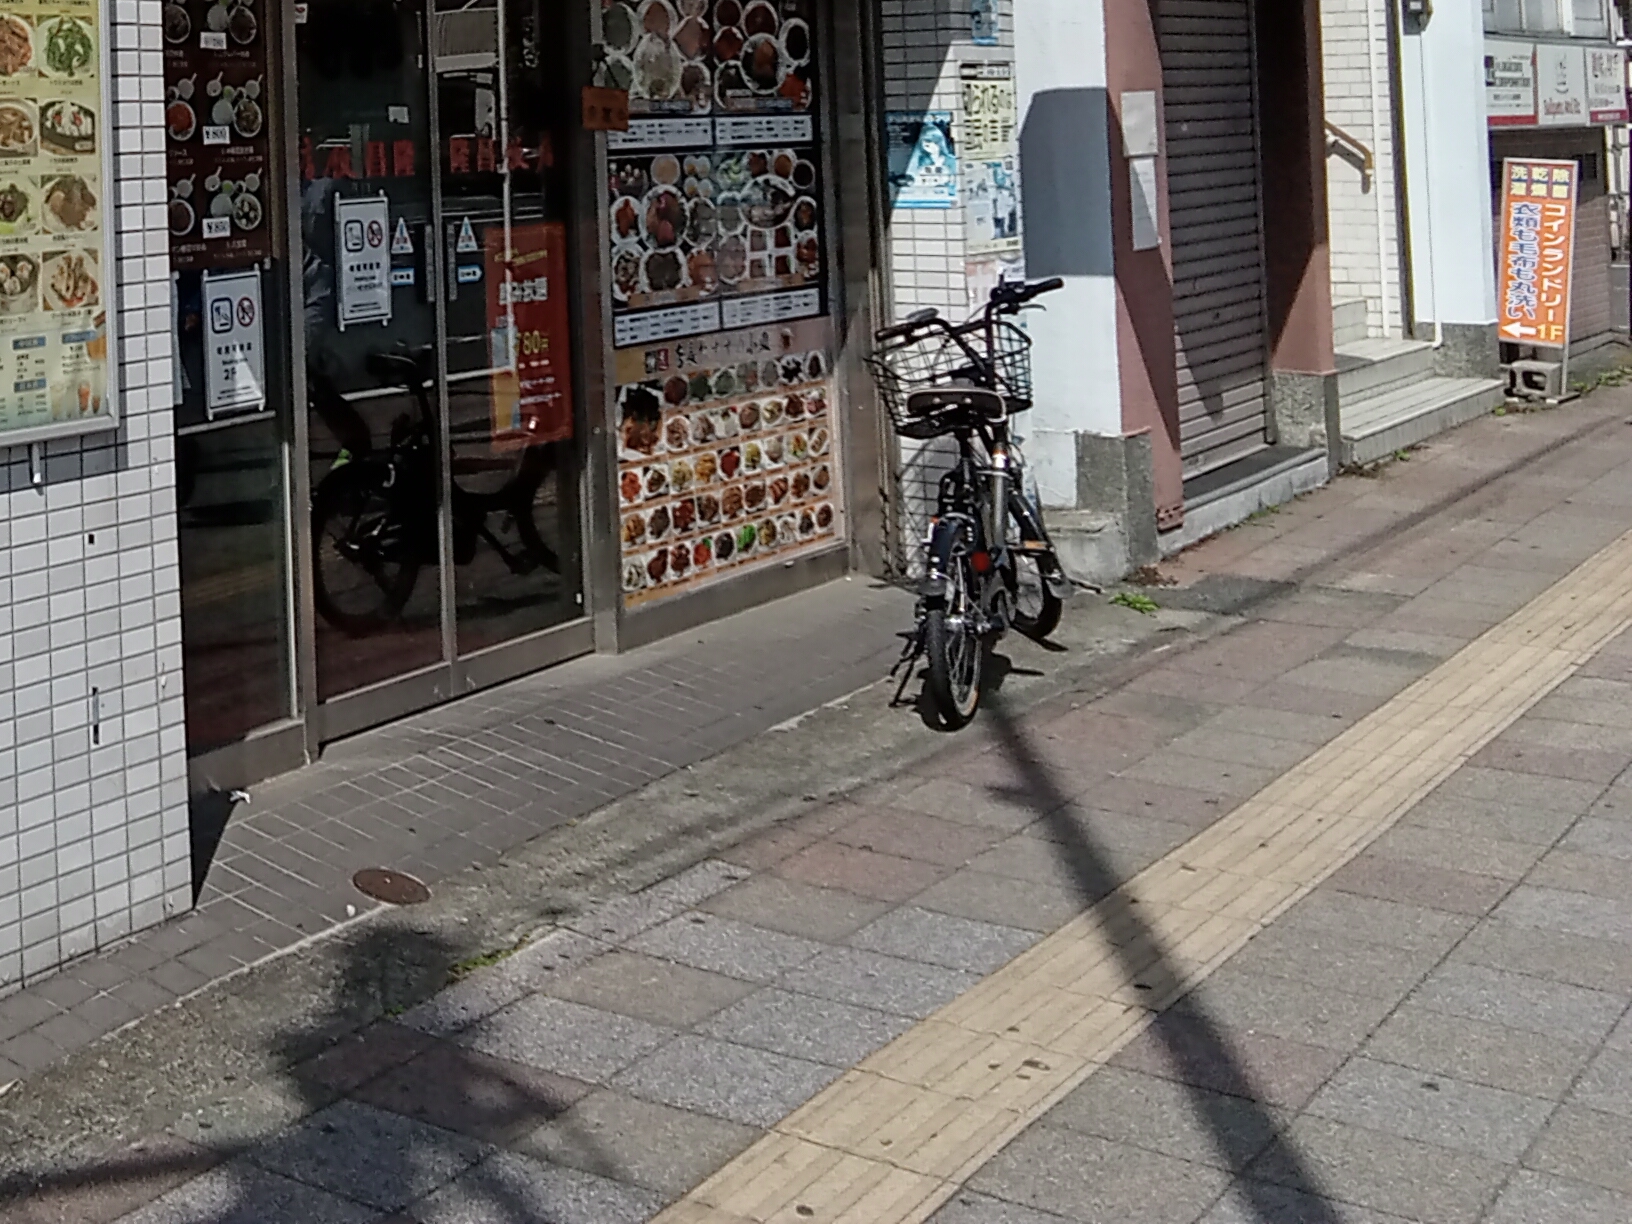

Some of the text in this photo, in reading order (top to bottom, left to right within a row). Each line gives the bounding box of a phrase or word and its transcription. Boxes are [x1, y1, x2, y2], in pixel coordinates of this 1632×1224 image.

[1507, 203, 1540, 319] 衣類も毛布も丸洗い
[1541, 204, 1566, 321] コインランドリー
[1537, 325, 1563, 340] 1F
